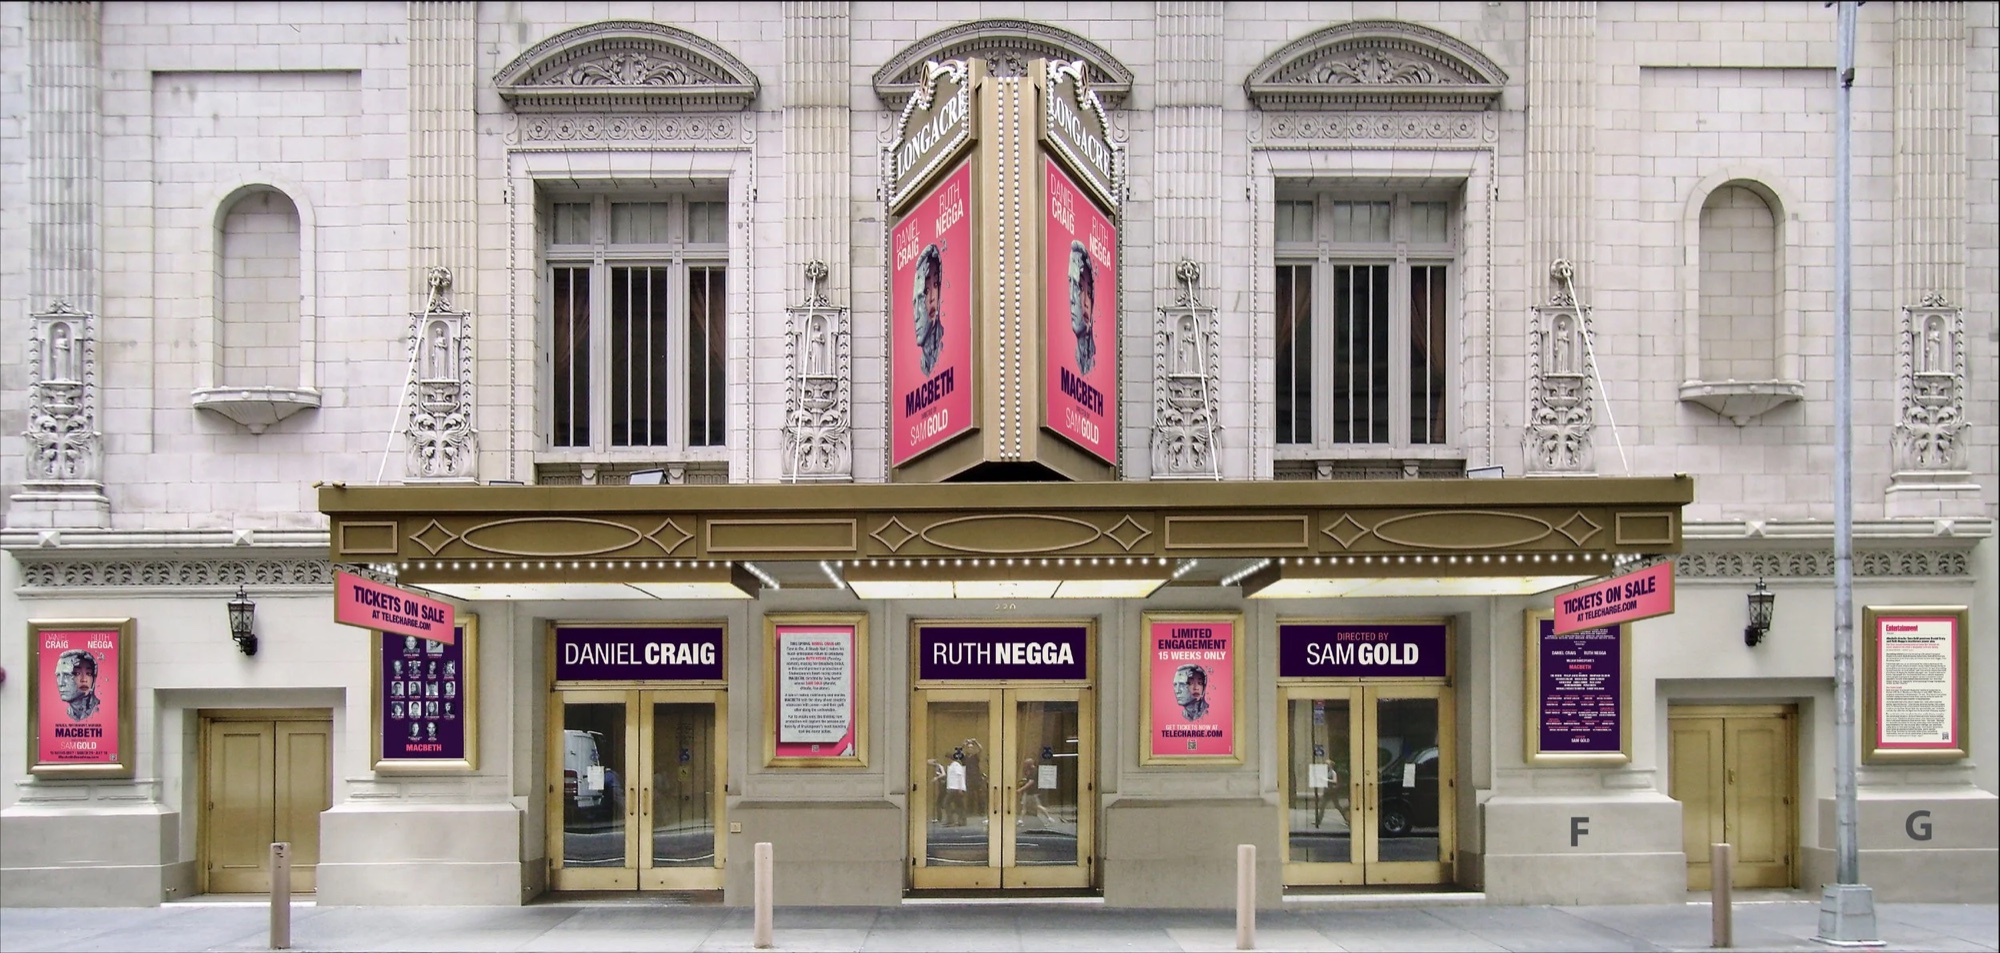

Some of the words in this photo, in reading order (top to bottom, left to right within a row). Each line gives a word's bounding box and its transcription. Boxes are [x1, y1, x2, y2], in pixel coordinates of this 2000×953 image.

[897, 87, 967, 180] LONGACRE
[1049, 97, 1110, 179] LONGACRE
[939, 180, 961, 212] RUTH
[1050, 173, 1076, 217] DANIEL
[935, 198, 964, 239] NEGGA
[1052, 196, 1075, 236] CRAIG
[895, 217, 921, 253] DANIEL
[1092, 215, 1109, 249] RUTH
[896, 237, 920, 271] CRAIG
[1089, 233, 1112, 271] NEGGA
[905, 366, 954, 418] MACBETH
[1060, 366, 1104, 417] MACBETH
[910, 420, 927, 446] SAM
[927, 409, 948, 438] GOLD
[1065, 407, 1081, 434] SAM
[1081, 416, 1099, 445] GOLD
[353, 585, 401, 613] TICKETS
[404, 600, 418, 617] ON
[421, 605, 445, 624] SALE
[1563, 591, 1603, 614] TICKETS
[1605, 585, 1621, 604] ON
[1624, 576, 1656, 599] SALE
[372, 609, 380, 619] AT
[382, 612, 432, 631] TELECHARGE.COM
[1577, 612, 1584, 622] AT
[1585, 600, 1637, 621] TELECHARGE.COM
[45, 633, 68, 641] DANIEL
[45, 641, 69, 649] CRAIG
[87, 641, 113, 649] NEGGA
[90, 633, 109, 641] RUTH
[1158, 639, 1227, 650] ENGAGEMENT
[1171, 628, 1212, 639] LIMITED
[1337, 632, 1376, 641] DIRECTED
[1378, 632, 1389, 641] BY
[565, 643, 641, 665] DANIEL
[644, 642, 715, 665] CRAIG
[933, 643, 991, 665] RUTH
[995, 642, 1074, 665] NEGGA
[1158, 652, 1169, 660] 15
[1171, 652, 1201, 660] WEEKS
[1204, 652, 1226, 660] ONLY
[1306, 643, 1354, 665] SAM
[1358, 643, 1419, 665] GOLD
[55, 728, 102, 738] MACBETH
[1161, 730, 1222, 738] TELECHARGE.COM
[60, 741, 76, 749] SAM
[76, 741, 97, 749] GOLD
[406, 744, 442, 752] MACBETH
